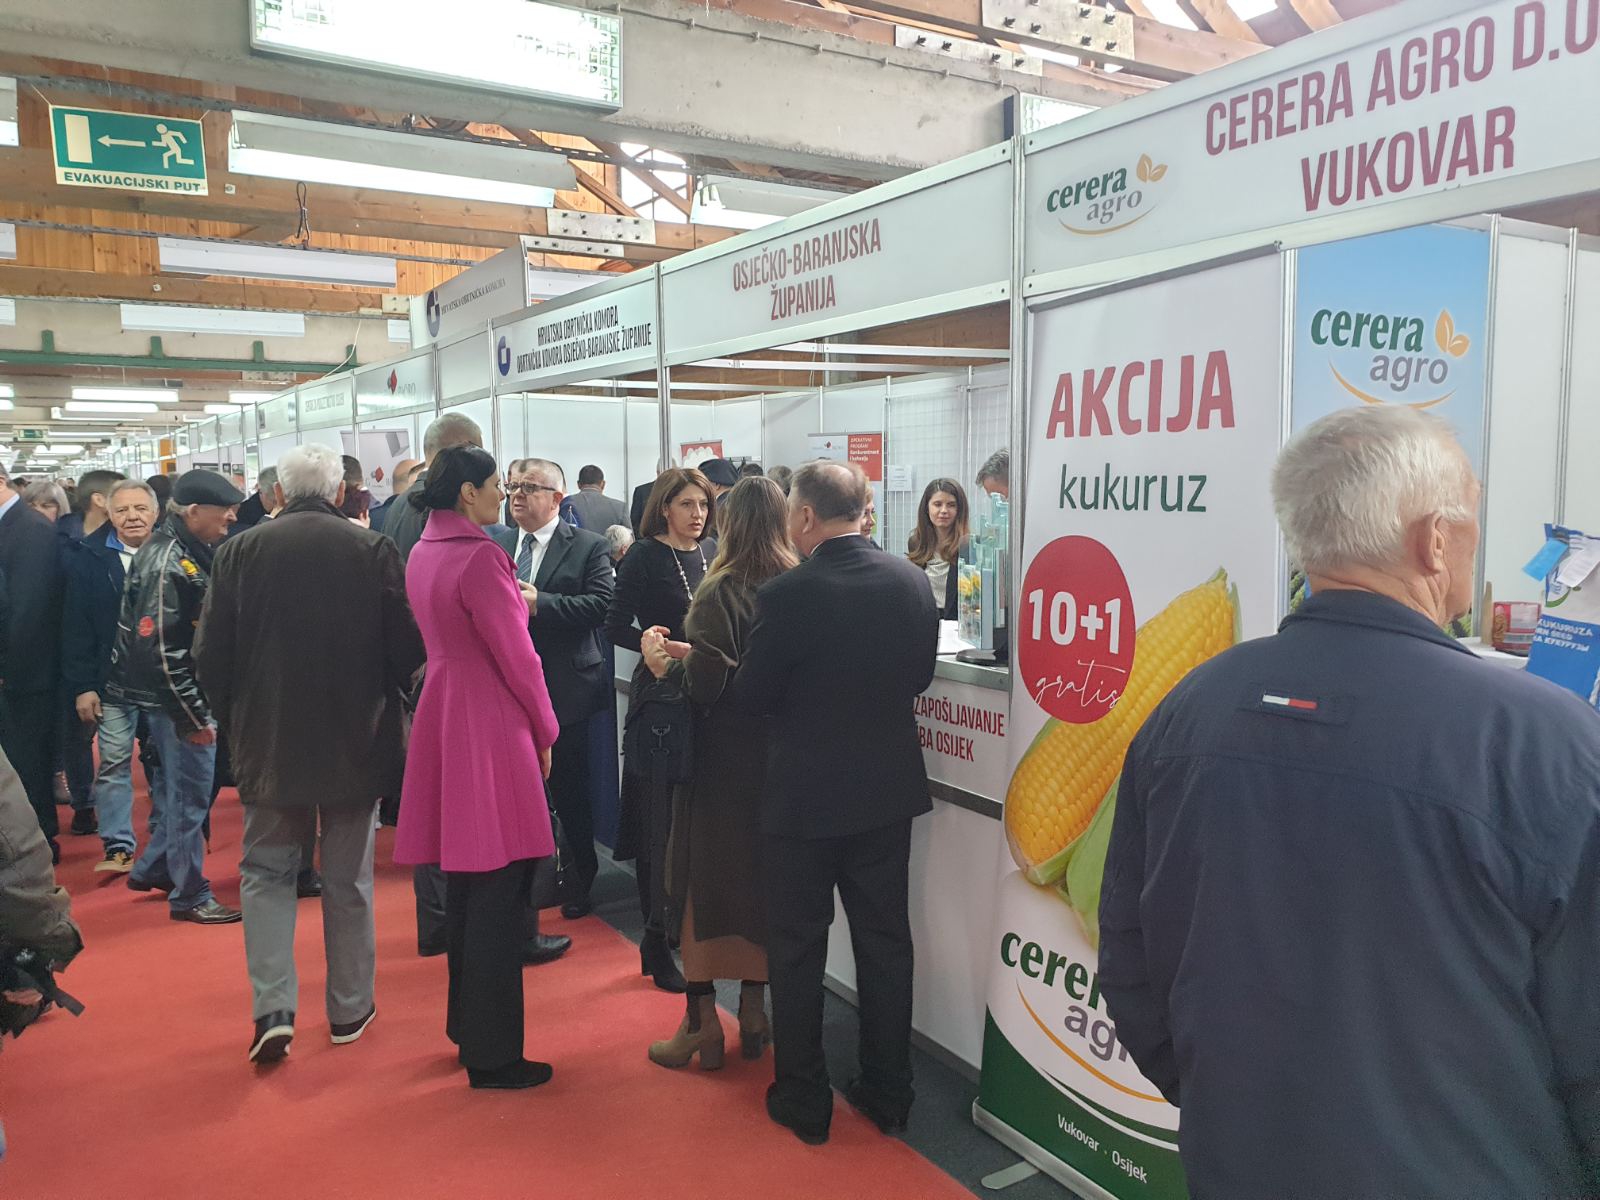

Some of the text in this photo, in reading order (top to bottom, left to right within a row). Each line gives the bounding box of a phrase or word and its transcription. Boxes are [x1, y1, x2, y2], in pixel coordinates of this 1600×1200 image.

[1206, 60, 1354, 156] CERERA
[1367, 15, 1495, 113] AGRO
[64, 172, 200, 191] EVAKUACIJSKI PUT
[1301, 105, 1517, 213] VUKOVAR
[1046, 165, 1128, 214] cerera
[1086, 188, 1143, 225] agro
[732, 216, 882, 293] OSJEČKO-BARANJSKA
[770, 274, 836, 321] ŽUPANIJA
[537, 305, 619, 347] HRVATSKA OBRTNIČKA KOMORA
[1310, 308, 1424, 353] cerera
[542, 346, 563, 368] KOMORA
[1369, 352, 1448, 392] agro
[1046, 349, 1235, 440] AKCIJA
[1059, 462, 1208, 513] kukuruz
[1028, 587, 1122, 656] 10+1
[1036, 658, 1125, 712] gratis
[914, 694, 1006, 738] ZAPOŠLJAVANJE
[917, 724, 975, 763] BA OSIJEK
[1000, 930, 1099, 1009] cerer
[1064, 1004, 1128, 1062] ag
[1057, 1113, 1149, 1185] Vukovar Osijek
